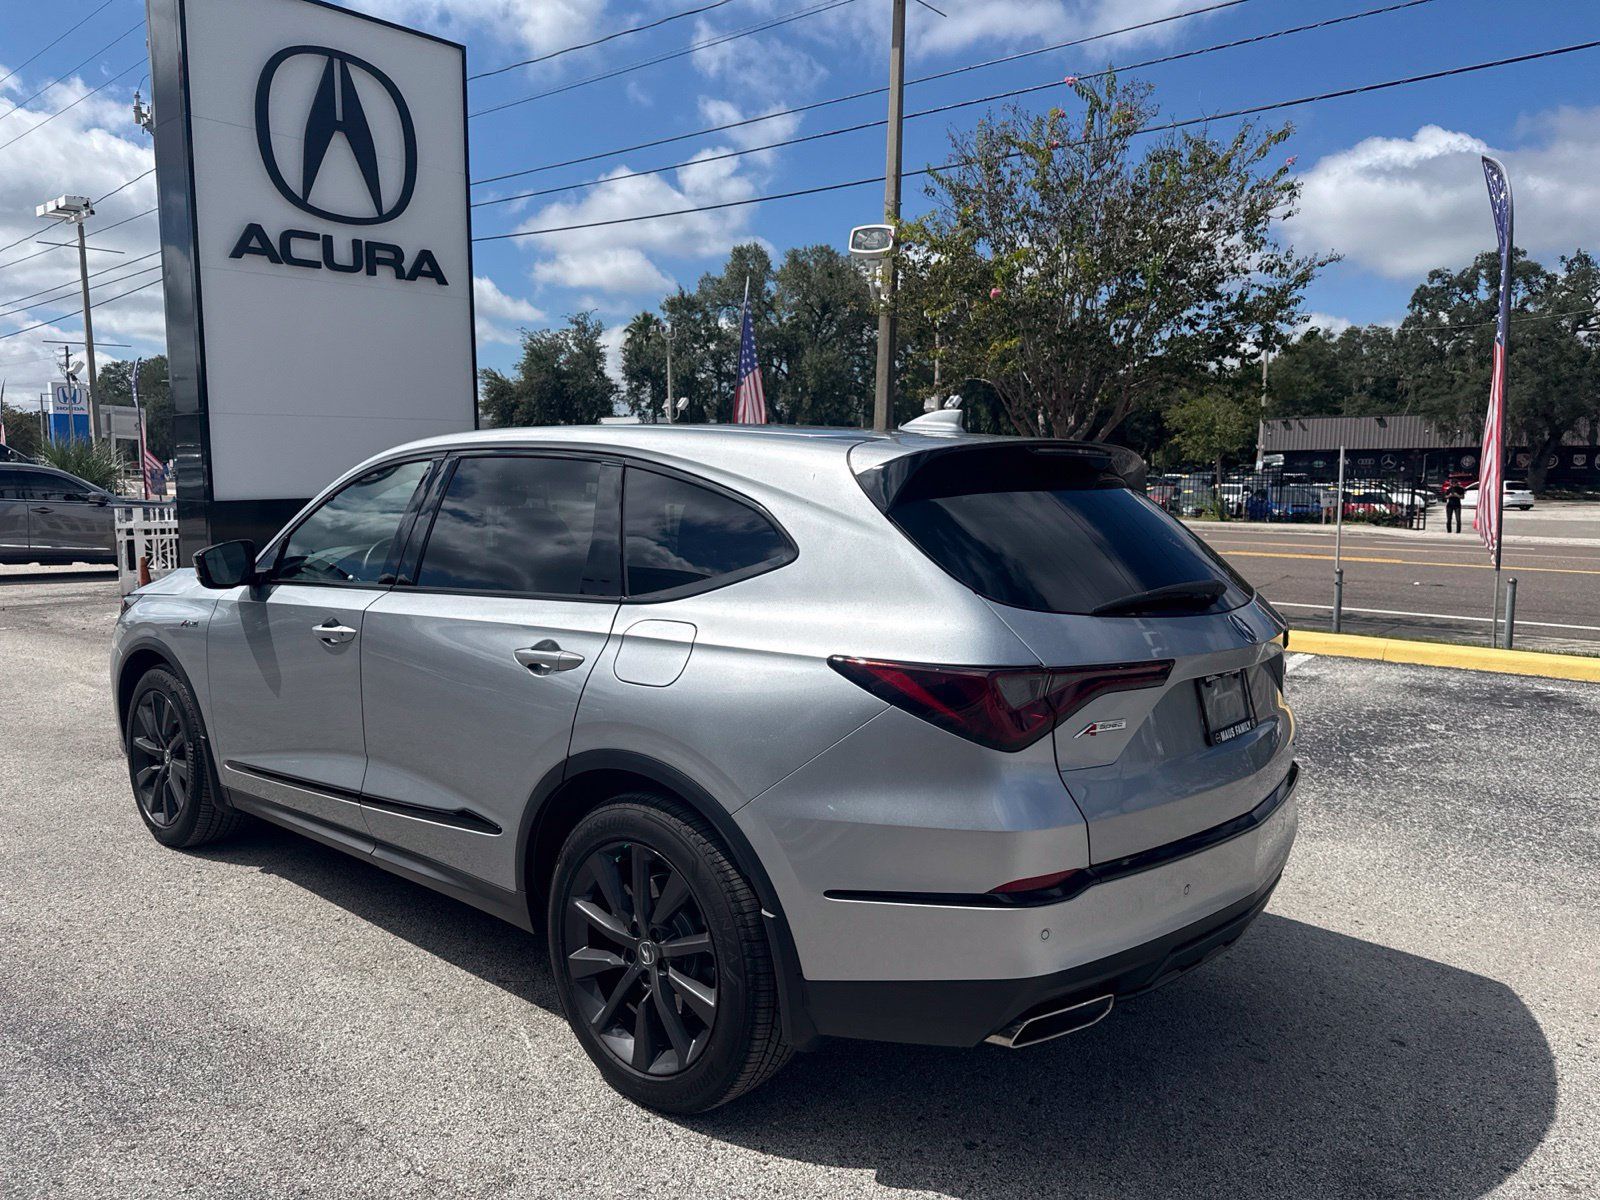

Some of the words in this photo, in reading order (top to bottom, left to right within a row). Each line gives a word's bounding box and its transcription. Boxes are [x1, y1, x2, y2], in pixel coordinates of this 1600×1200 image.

[228, 222, 449, 286] ACURA
[1219, 727, 1236, 742] MAUS
[1234, 720, 1252, 736] FAMILY
